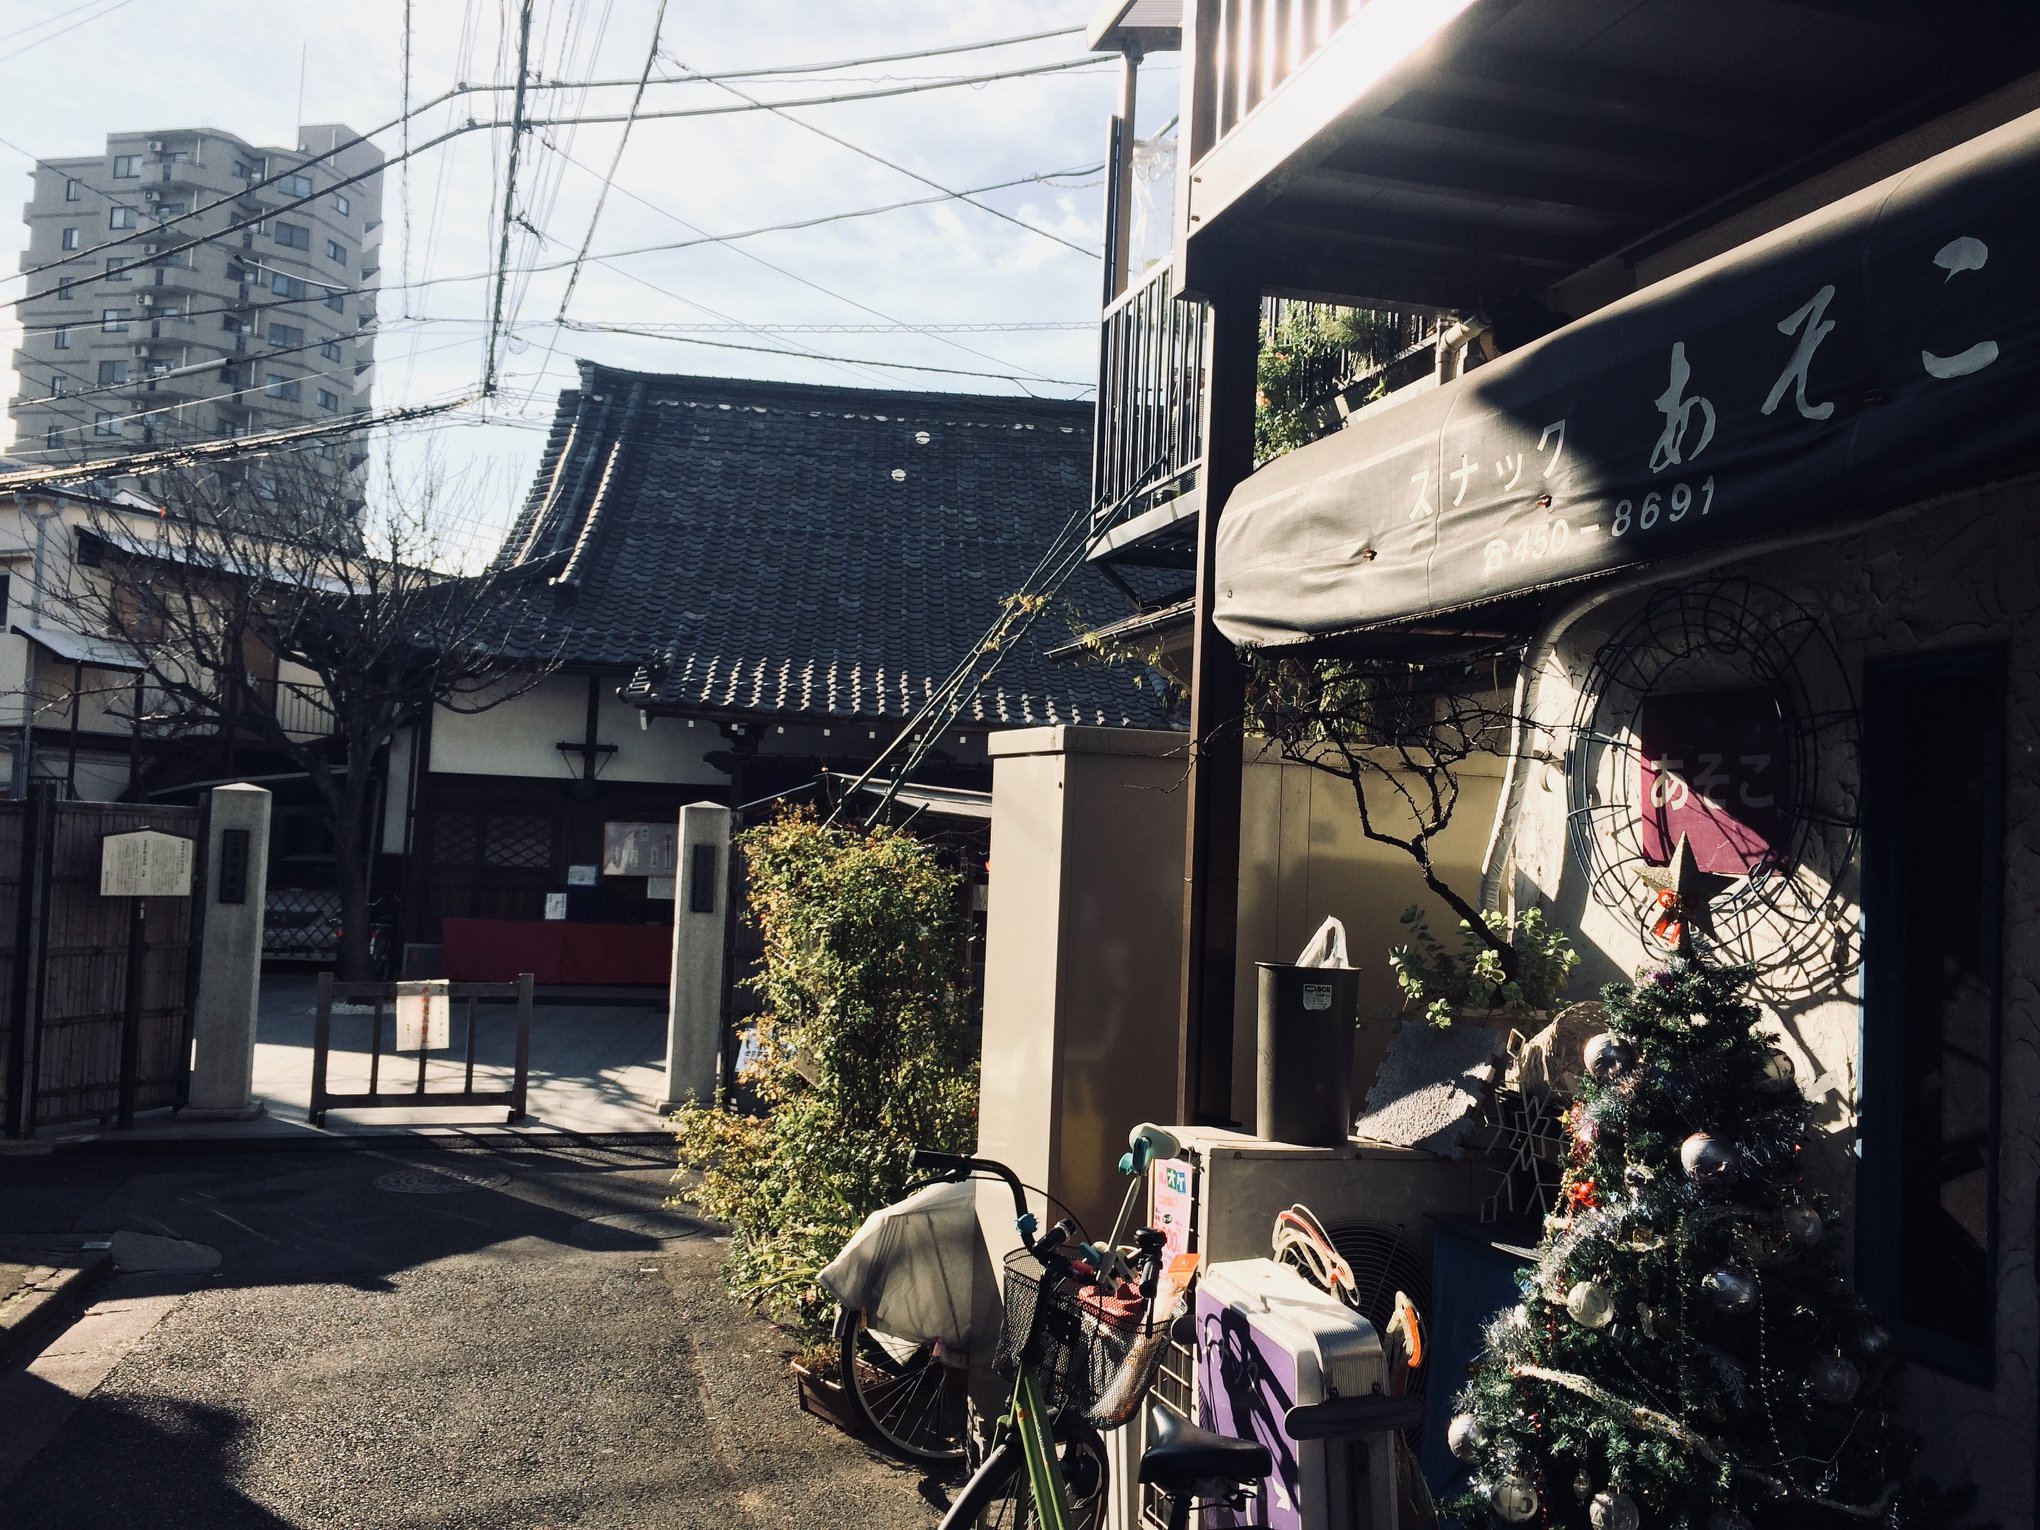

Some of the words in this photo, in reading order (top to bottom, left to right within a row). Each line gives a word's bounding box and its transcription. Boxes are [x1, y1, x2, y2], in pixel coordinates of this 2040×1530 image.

[1649, 236, 1999, 474] あそこ
[1408, 419, 1566, 521] スナック
[1650, 752, 1775, 811] あそこ
